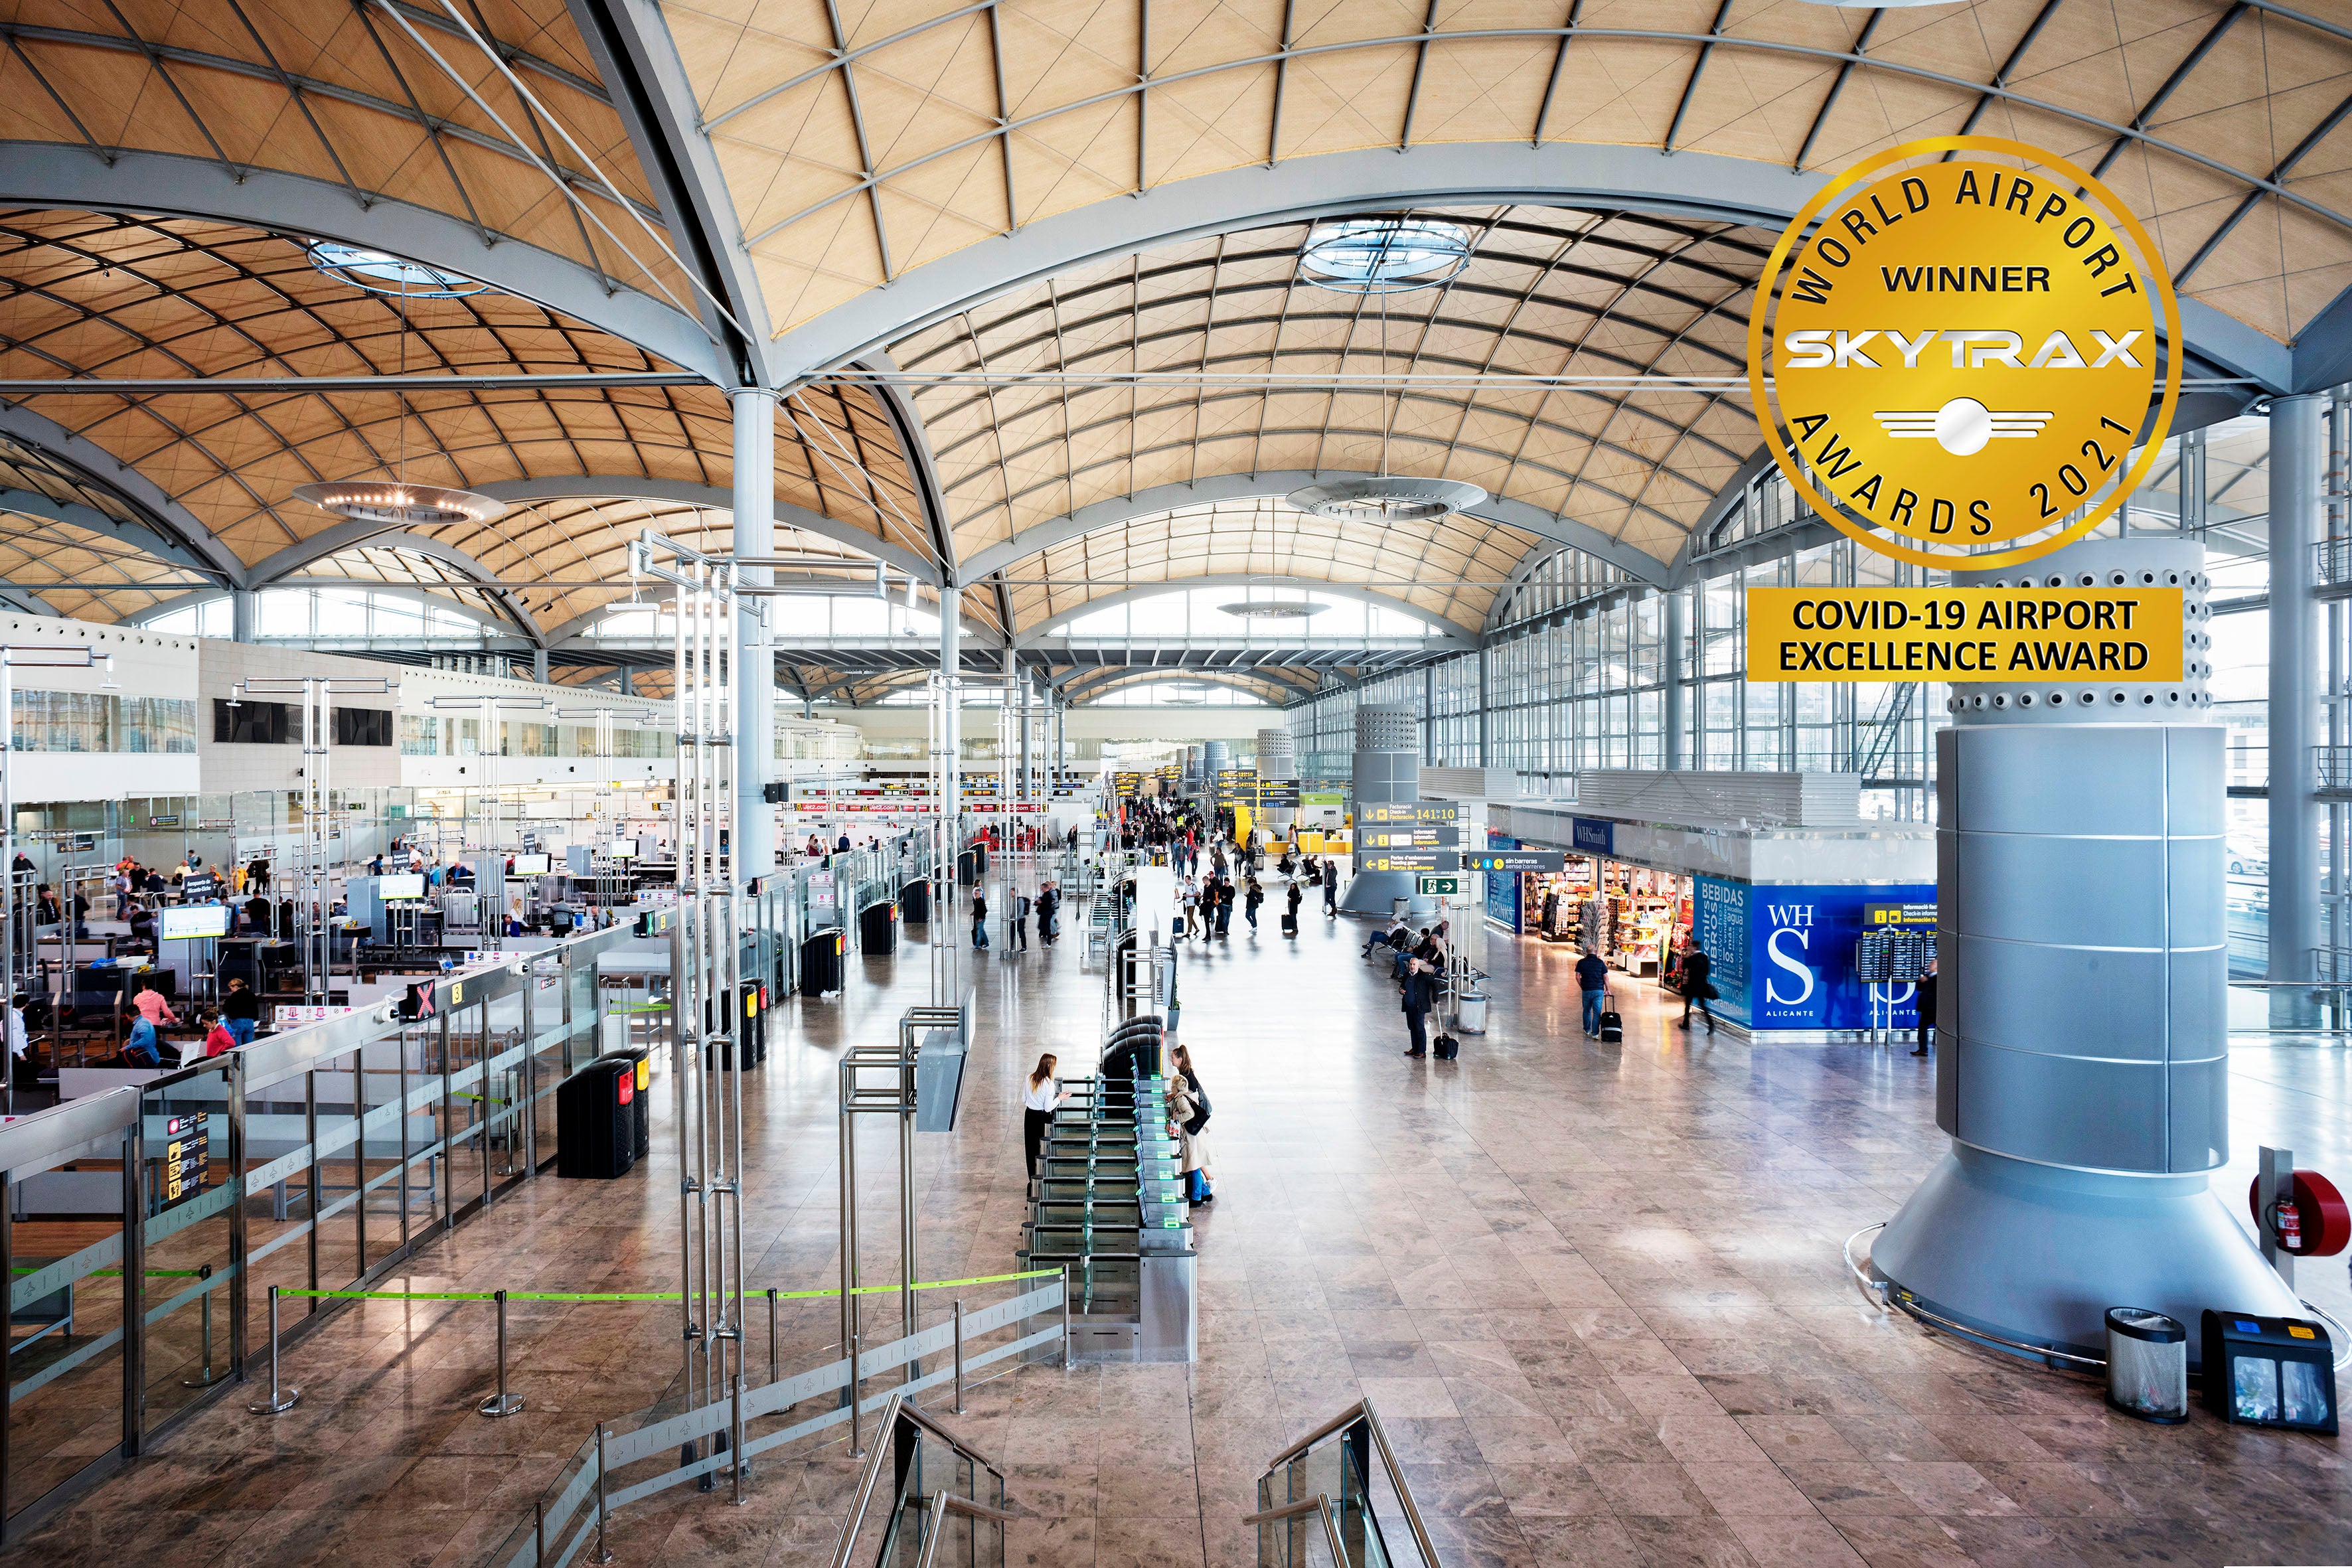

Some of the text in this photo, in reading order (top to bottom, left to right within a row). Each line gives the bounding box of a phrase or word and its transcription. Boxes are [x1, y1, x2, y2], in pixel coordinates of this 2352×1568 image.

[1417, 809, 1436, 819] 141
[1441, 809, 1454, 819] 10
[1576, 825, 1606, 845] WHSmith
[1702, 882, 1744, 907] BEBIDAS
[1490, 900, 1513, 922] DRINKS
[1727, 913, 1743, 925] agua
[1766, 905, 1814, 926] WH
[1723, 947, 1734, 963] los
[1766, 927, 1814, 1005] S
[454, 986, 459, 1000] 3
